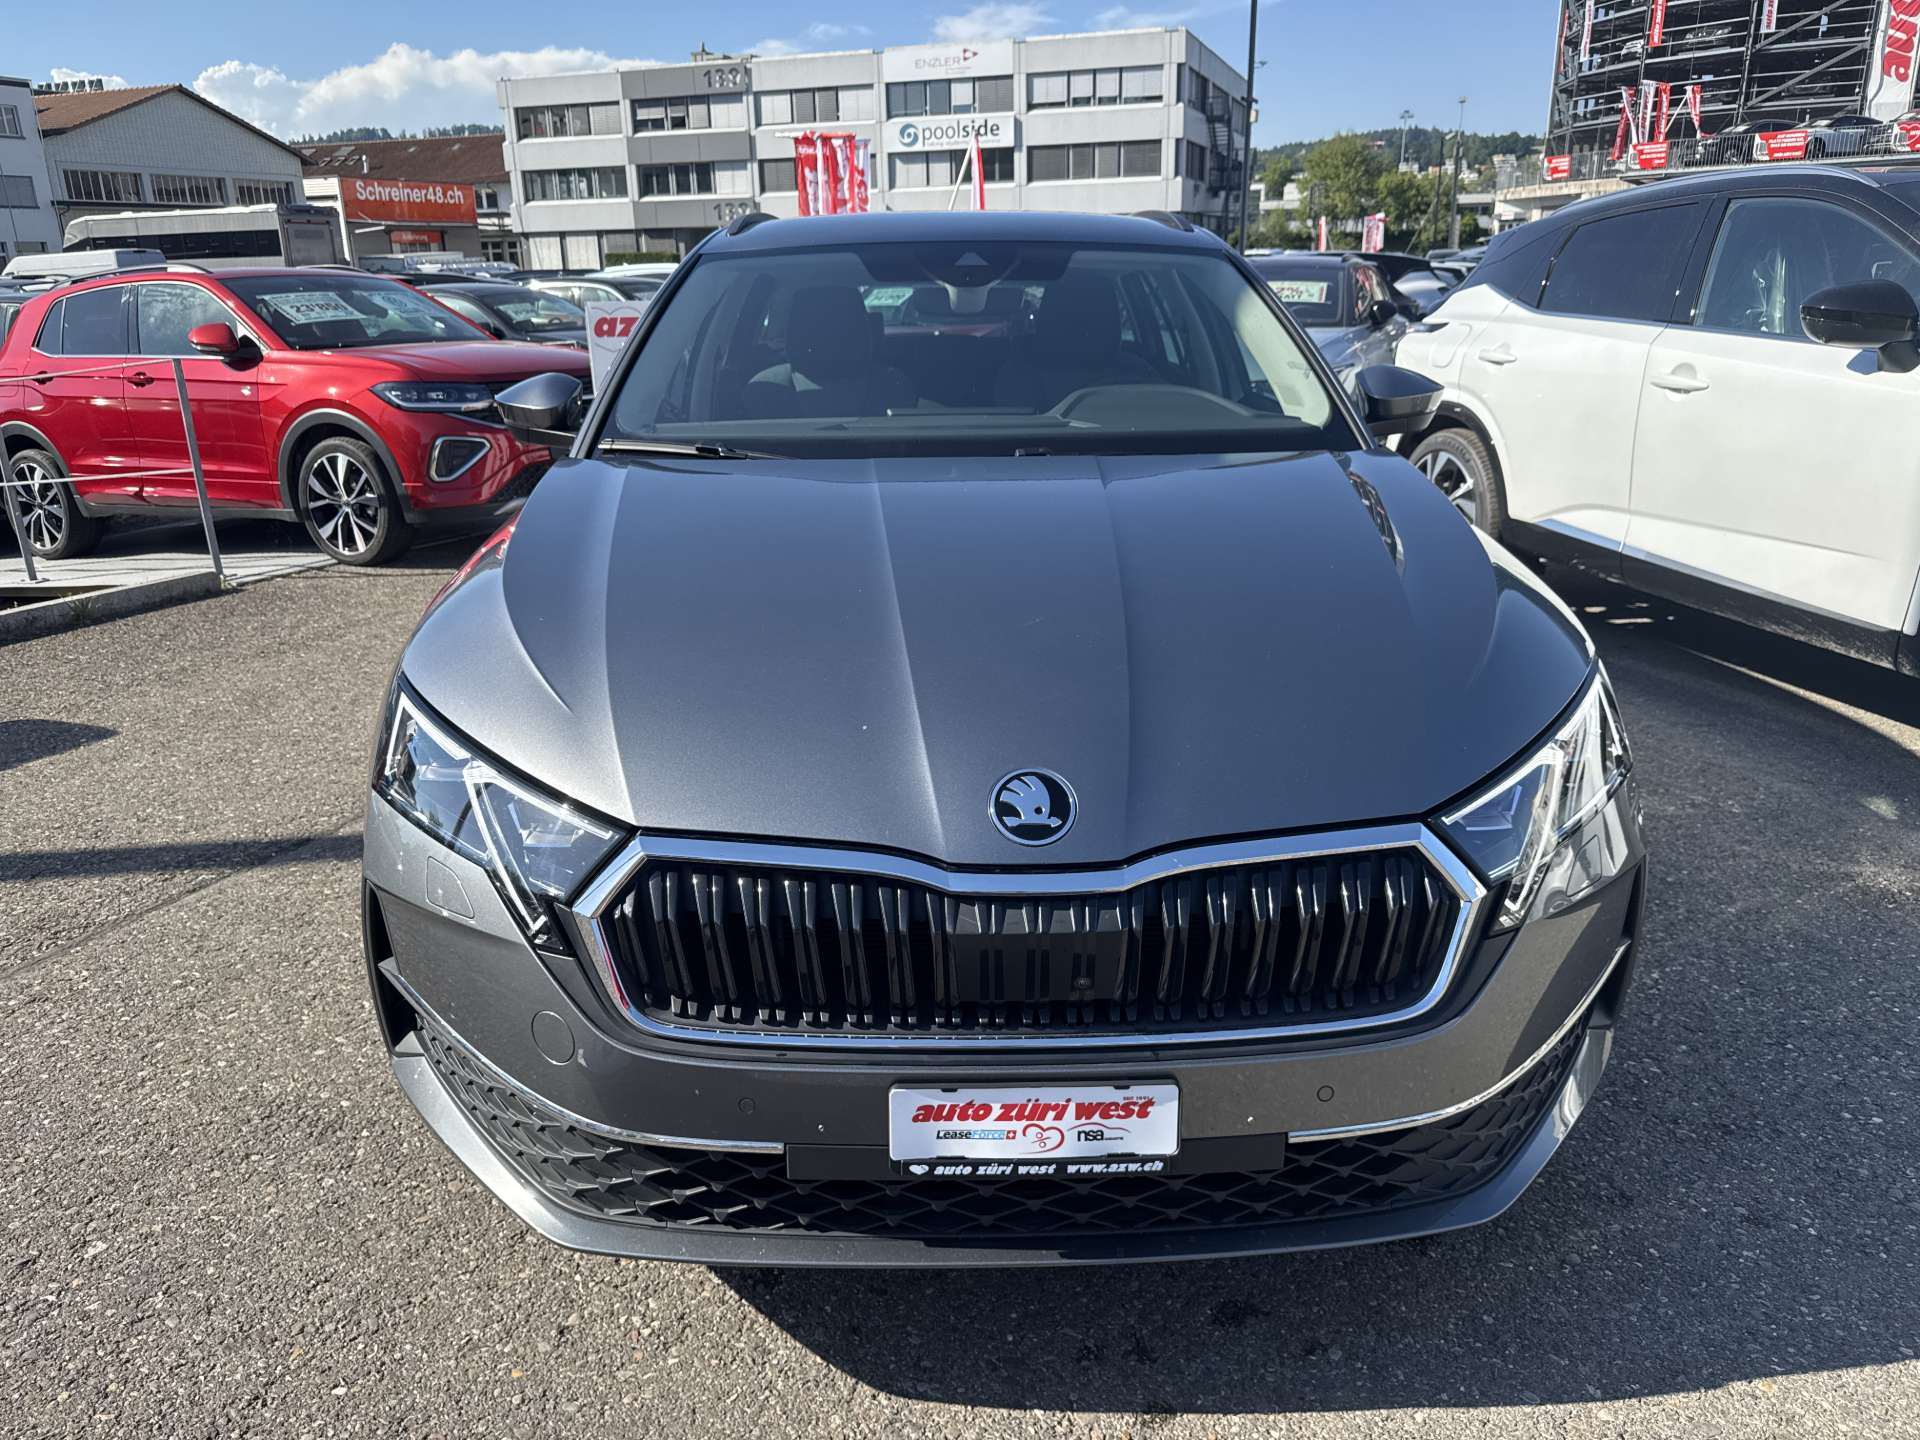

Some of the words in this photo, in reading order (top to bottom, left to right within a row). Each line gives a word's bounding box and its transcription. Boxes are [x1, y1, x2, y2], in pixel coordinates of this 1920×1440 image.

[915, 57, 961, 70] ENZLER
[922, 119, 1000, 147] poolside
[356, 180, 464, 205] Schreiner48.ch
[911, 1098, 993, 1123] auto
[993, 1097, 1072, 1122] züri
[1074, 1097, 1156, 1121] west
[1077, 1130, 1104, 1142] nsa
[933, 1163, 973, 1175] auto
[976, 1161, 1014, 1175] züri
[1017, 1162, 1057, 1174] west
